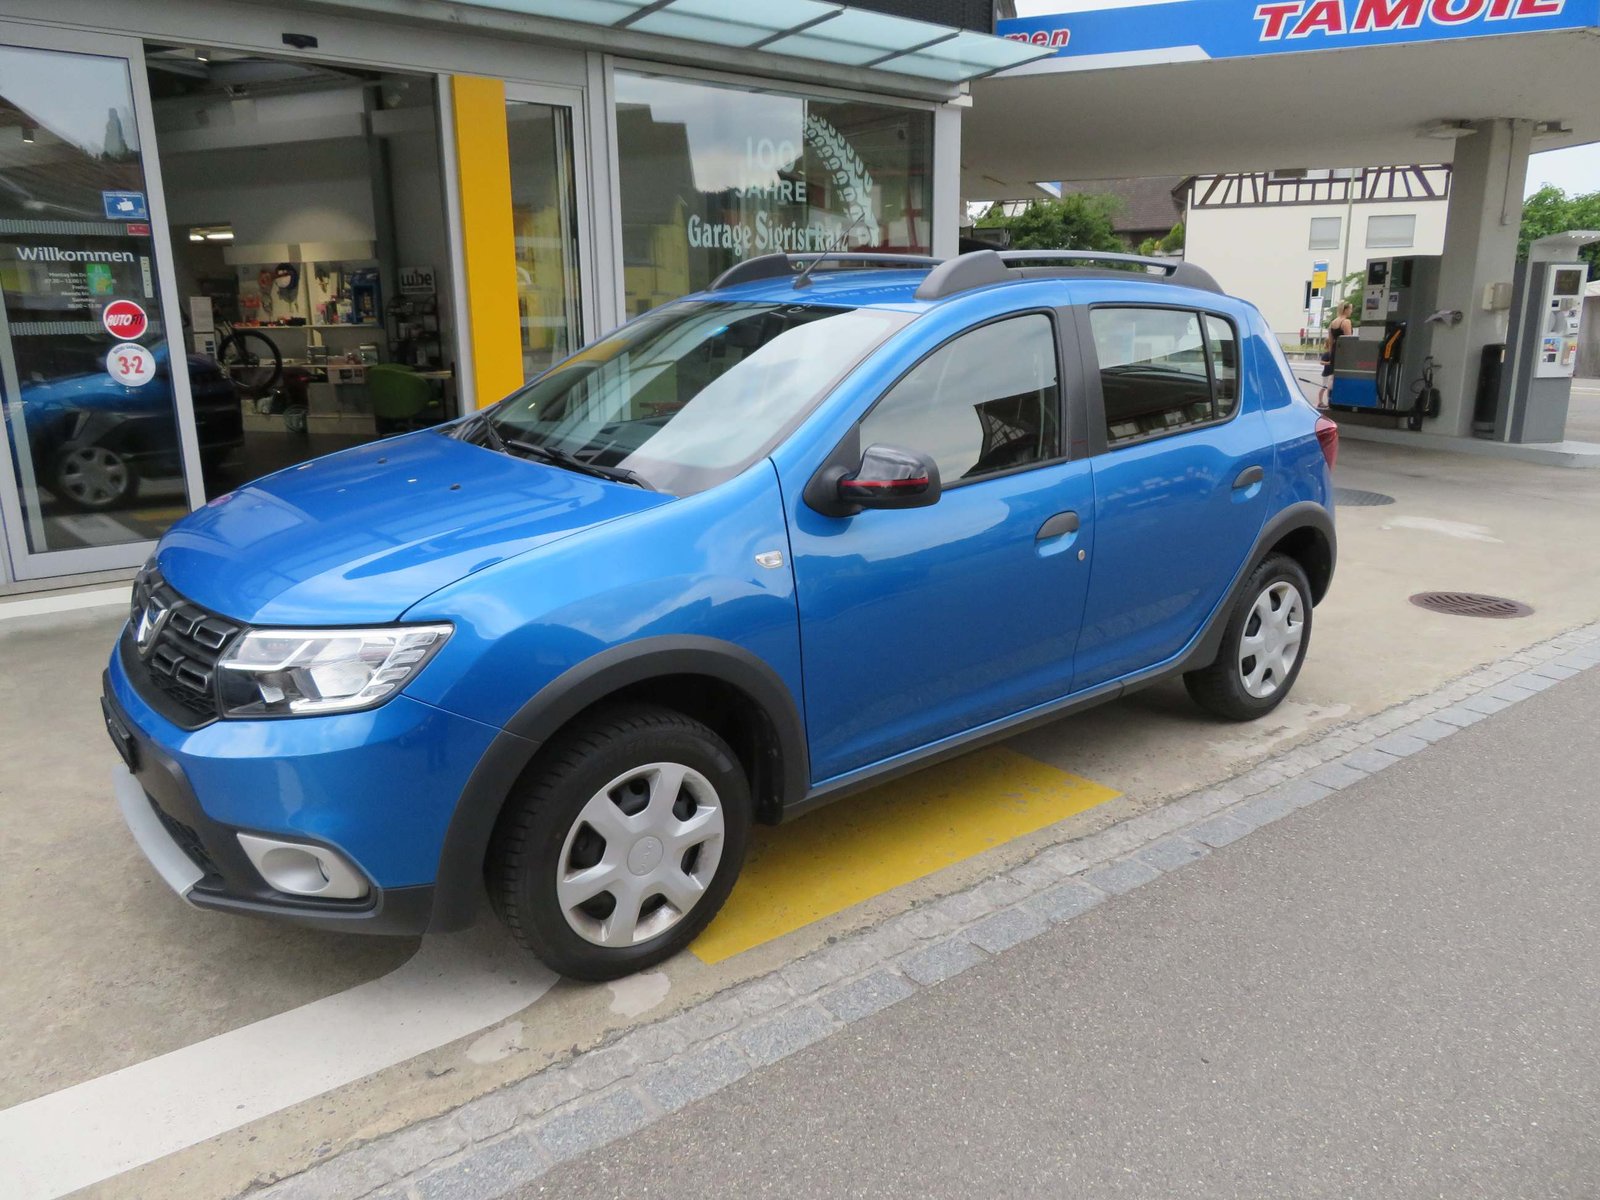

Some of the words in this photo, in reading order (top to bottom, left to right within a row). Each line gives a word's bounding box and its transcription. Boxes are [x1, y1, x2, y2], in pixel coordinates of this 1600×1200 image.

[746, 136, 796, 173] 100
[735, 179, 807, 202] JAHRE
[688, 214, 752, 256] Garage
[754, 210, 812, 253] Sigrist
[16, 246, 135, 262] Willkommen
